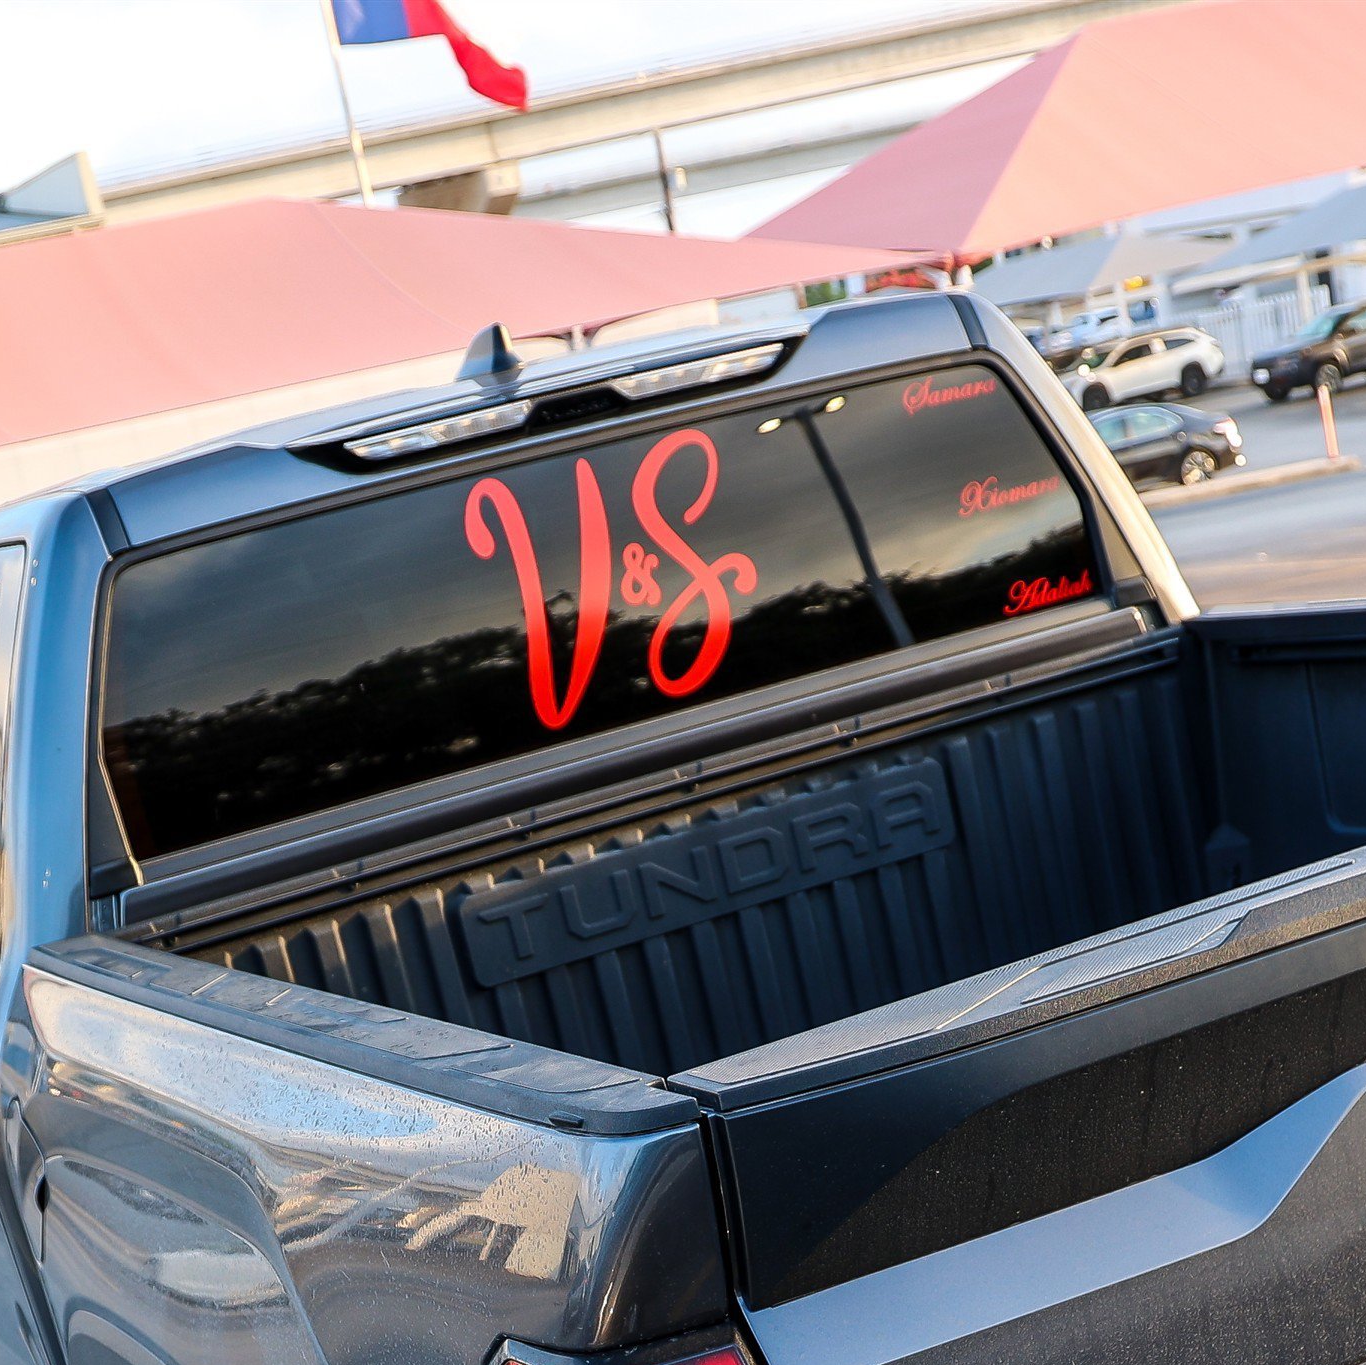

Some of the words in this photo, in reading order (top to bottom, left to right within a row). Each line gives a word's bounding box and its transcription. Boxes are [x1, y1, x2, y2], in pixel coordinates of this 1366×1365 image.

[902, 376, 996, 415] Samara
[959, 476, 1060, 517] Xiomara
[477, 780, 942, 959] TUNDRA
